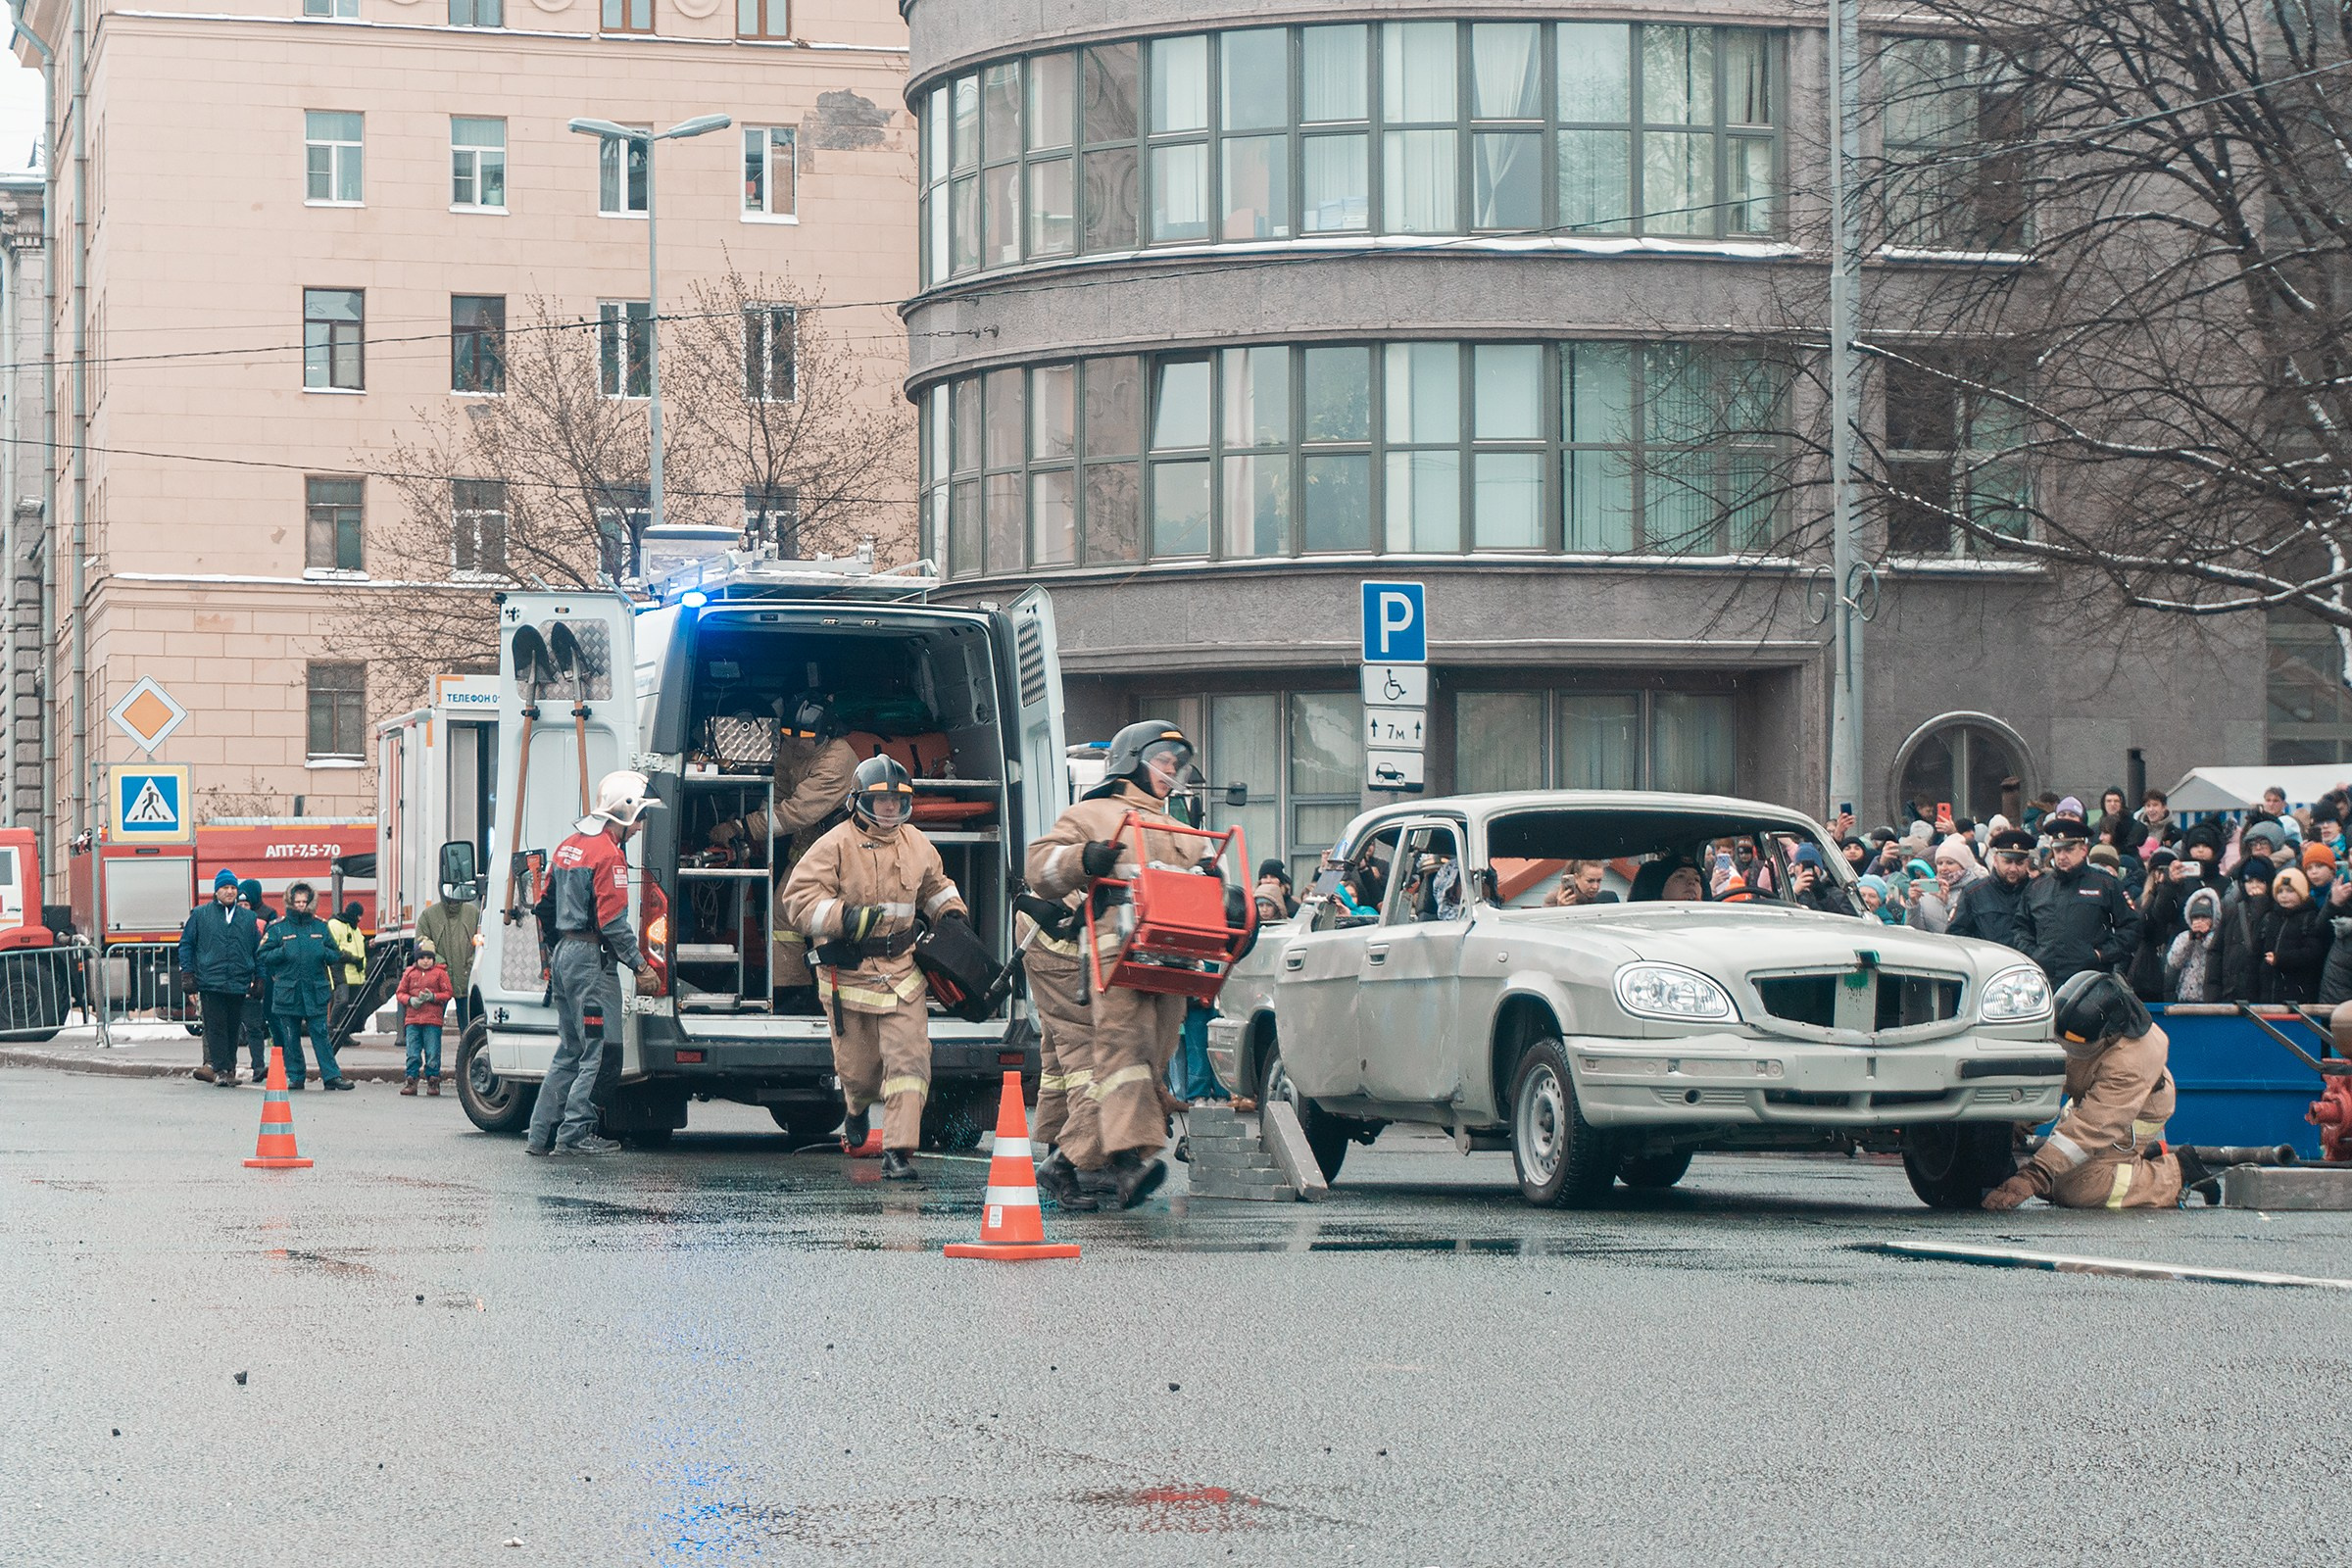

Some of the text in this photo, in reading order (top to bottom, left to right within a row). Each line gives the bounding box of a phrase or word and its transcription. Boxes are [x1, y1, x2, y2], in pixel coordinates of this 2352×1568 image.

[1380, 592, 1414, 653] P
[447, 693, 500, 704] ТЕЛЕФОН 0
[265, 844, 341, 858] АПТ-7,5-70
